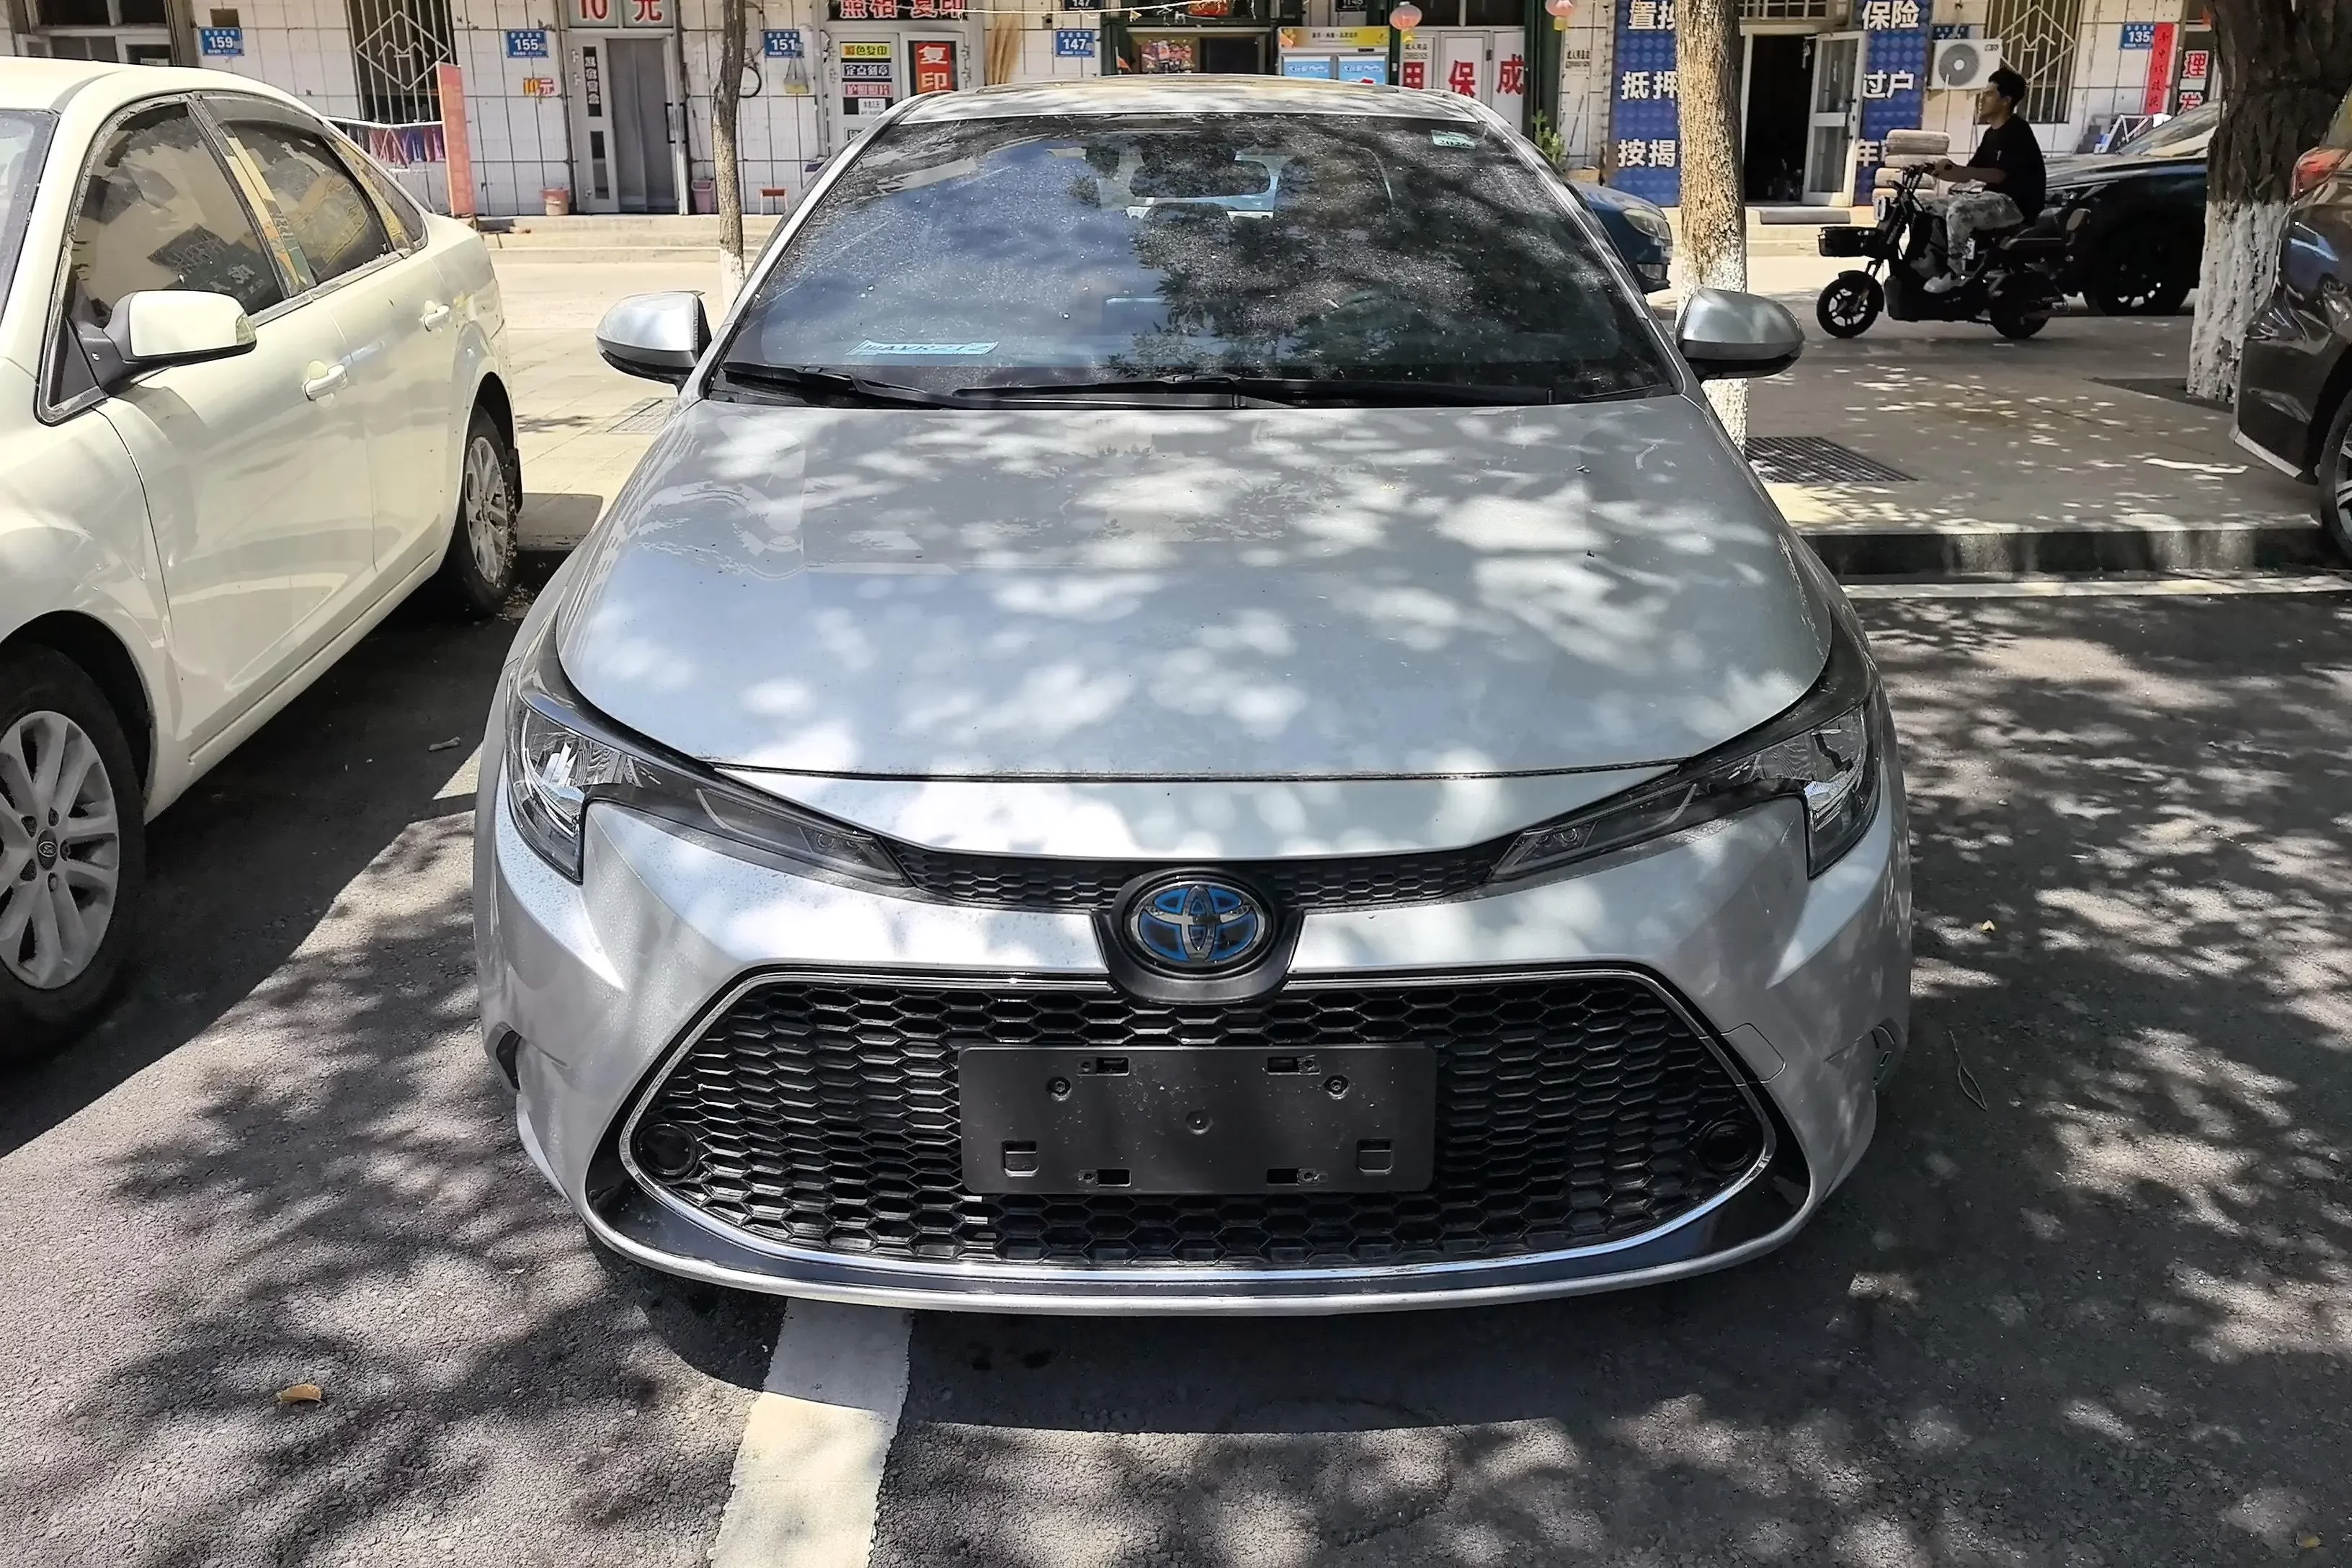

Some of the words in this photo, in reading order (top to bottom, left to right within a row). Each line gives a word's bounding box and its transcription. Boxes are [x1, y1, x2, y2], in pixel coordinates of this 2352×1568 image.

[1862, 0, 1920, 30] 保险
[209, 36, 233, 49] 159
[514, 38, 539, 51] 155
[771, 38, 796, 51] 151
[1063, 37, 1087, 50] 147
[2128, 31, 2151, 43] 135
[917, 46, 948, 89] 复印
[1448, 60, 1476, 98] 保
[1496, 53, 1525, 95] 成
[1621, 71, 1678, 100] 抵押
[1862, 69, 1915, 99] 过户
[1617, 138, 1676, 168] 按揭
[1856, 139, 1889, 167] 年
